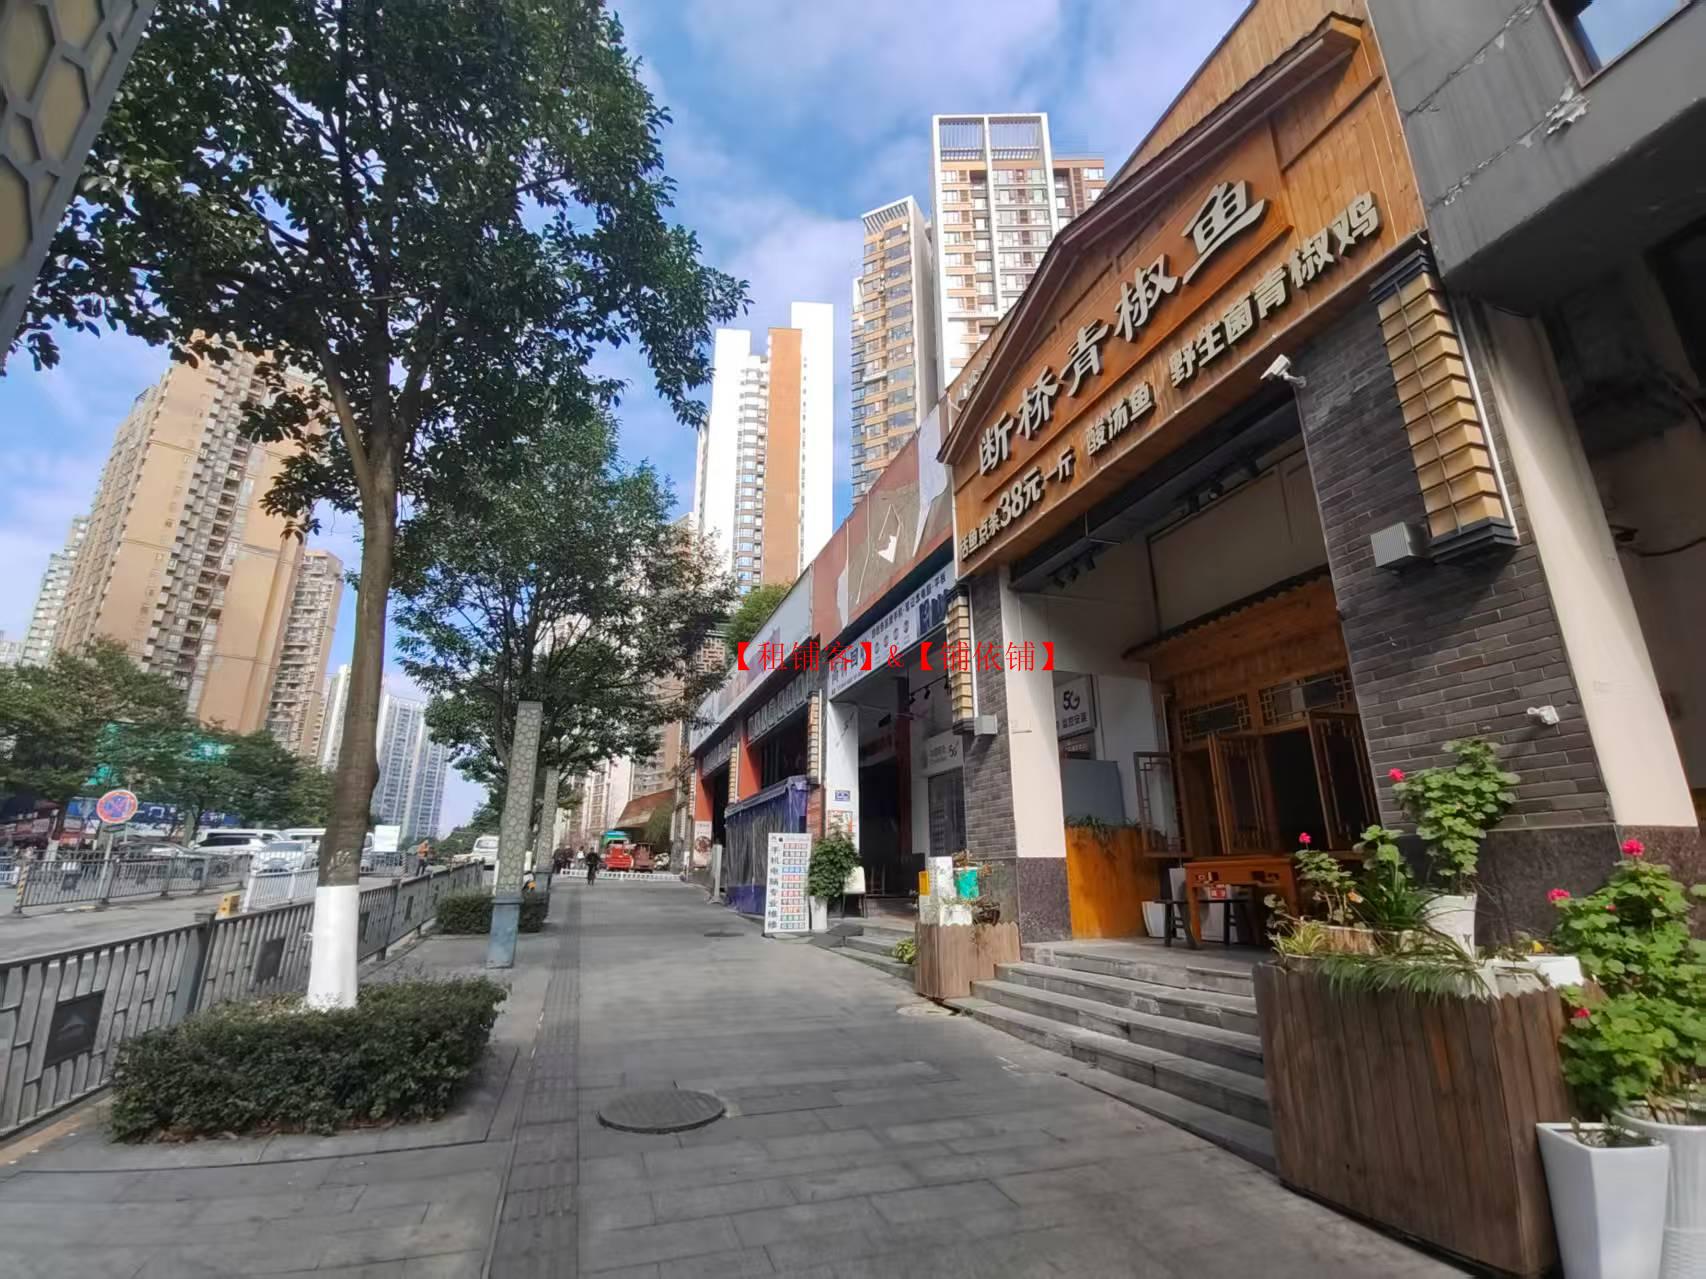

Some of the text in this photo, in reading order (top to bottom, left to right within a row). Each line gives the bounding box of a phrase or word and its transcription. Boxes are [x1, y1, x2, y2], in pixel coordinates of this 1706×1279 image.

[980, 179, 1266, 475] 断桥青椒鱼
[1170, 190, 1380, 388] 野生菌青椒鸡
[1086, 382, 1154, 457] 酸汤鱼
[1063, 689, 1081, 710] 5G
